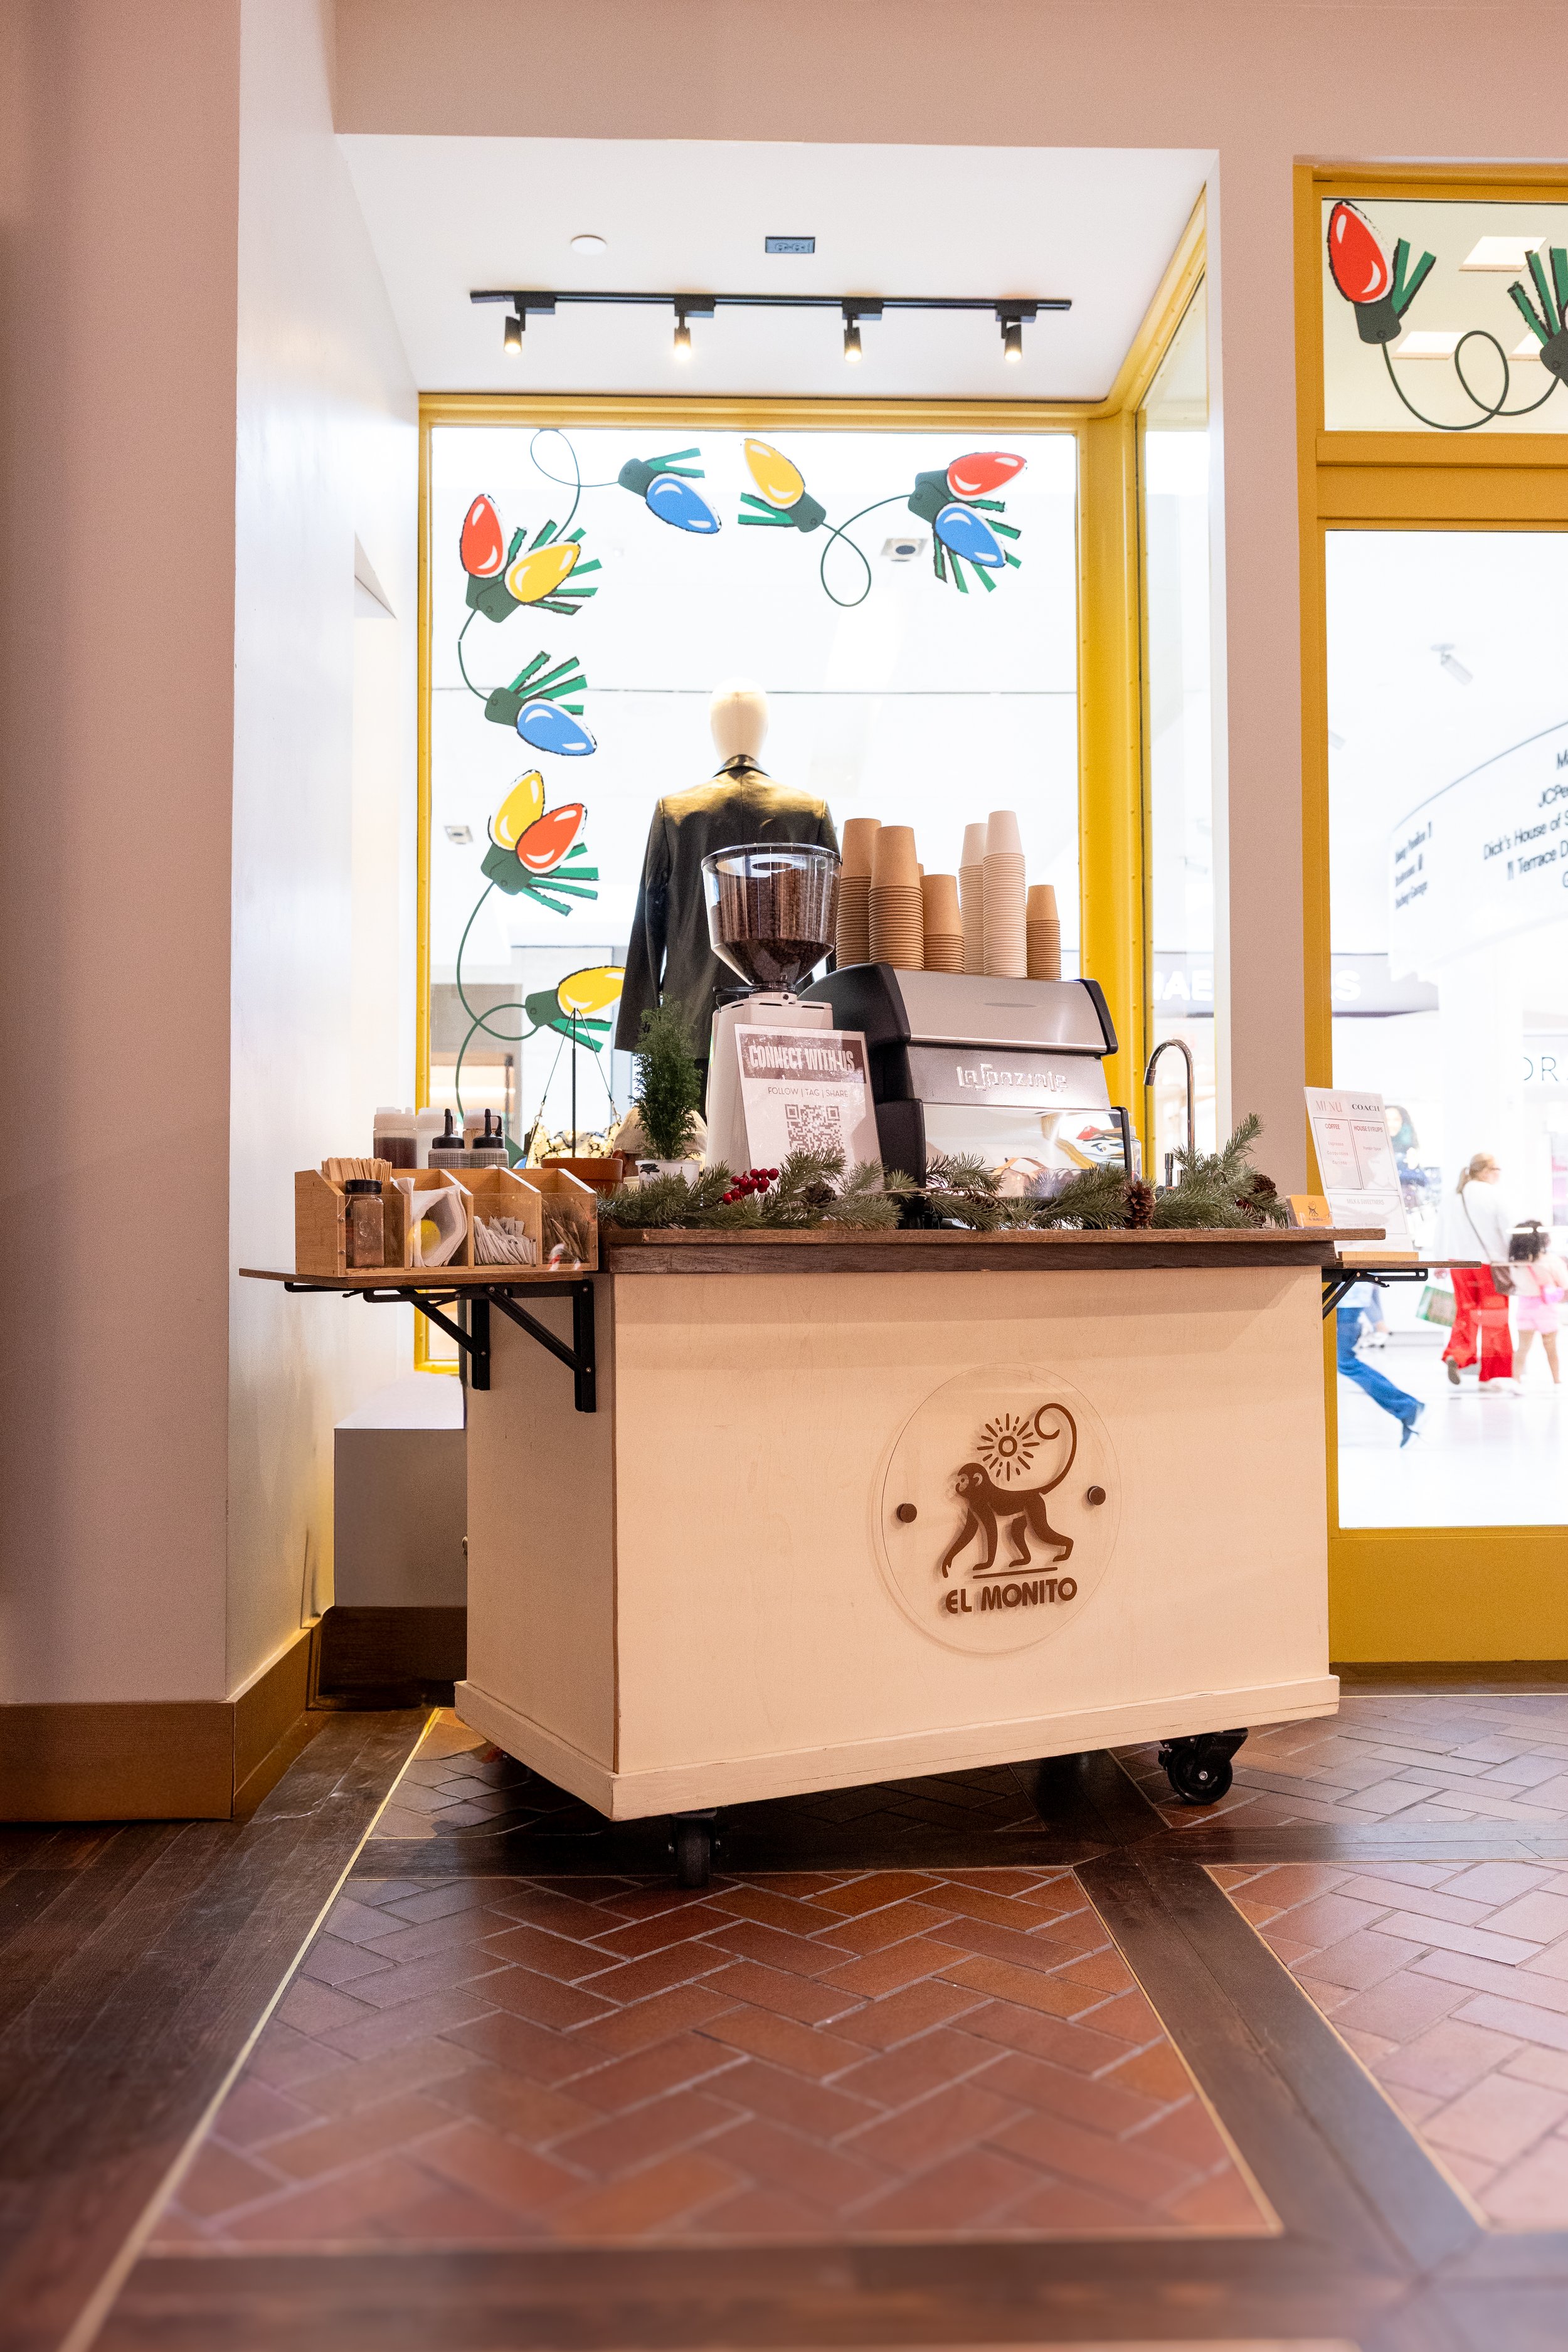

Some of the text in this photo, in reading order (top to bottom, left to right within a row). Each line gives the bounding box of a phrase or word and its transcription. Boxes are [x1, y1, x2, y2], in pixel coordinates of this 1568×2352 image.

[1484, 835, 1511, 860] Dick's
[1514, 824, 1546, 847] House
[1550, 813, 1562, 831] of
[1517, 849, 1557, 874] Terrace
[749, 1046, 856, 1072] CONNECT WITH US
[768, 1087, 799, 1095] FOLLOW
[805, 1088, 820, 1096] TAG
[826, 1089, 849, 1098] SHARE
[1352, 1103, 1380, 1112] COACH
[945, 1577, 1078, 1614] EL MONITO
